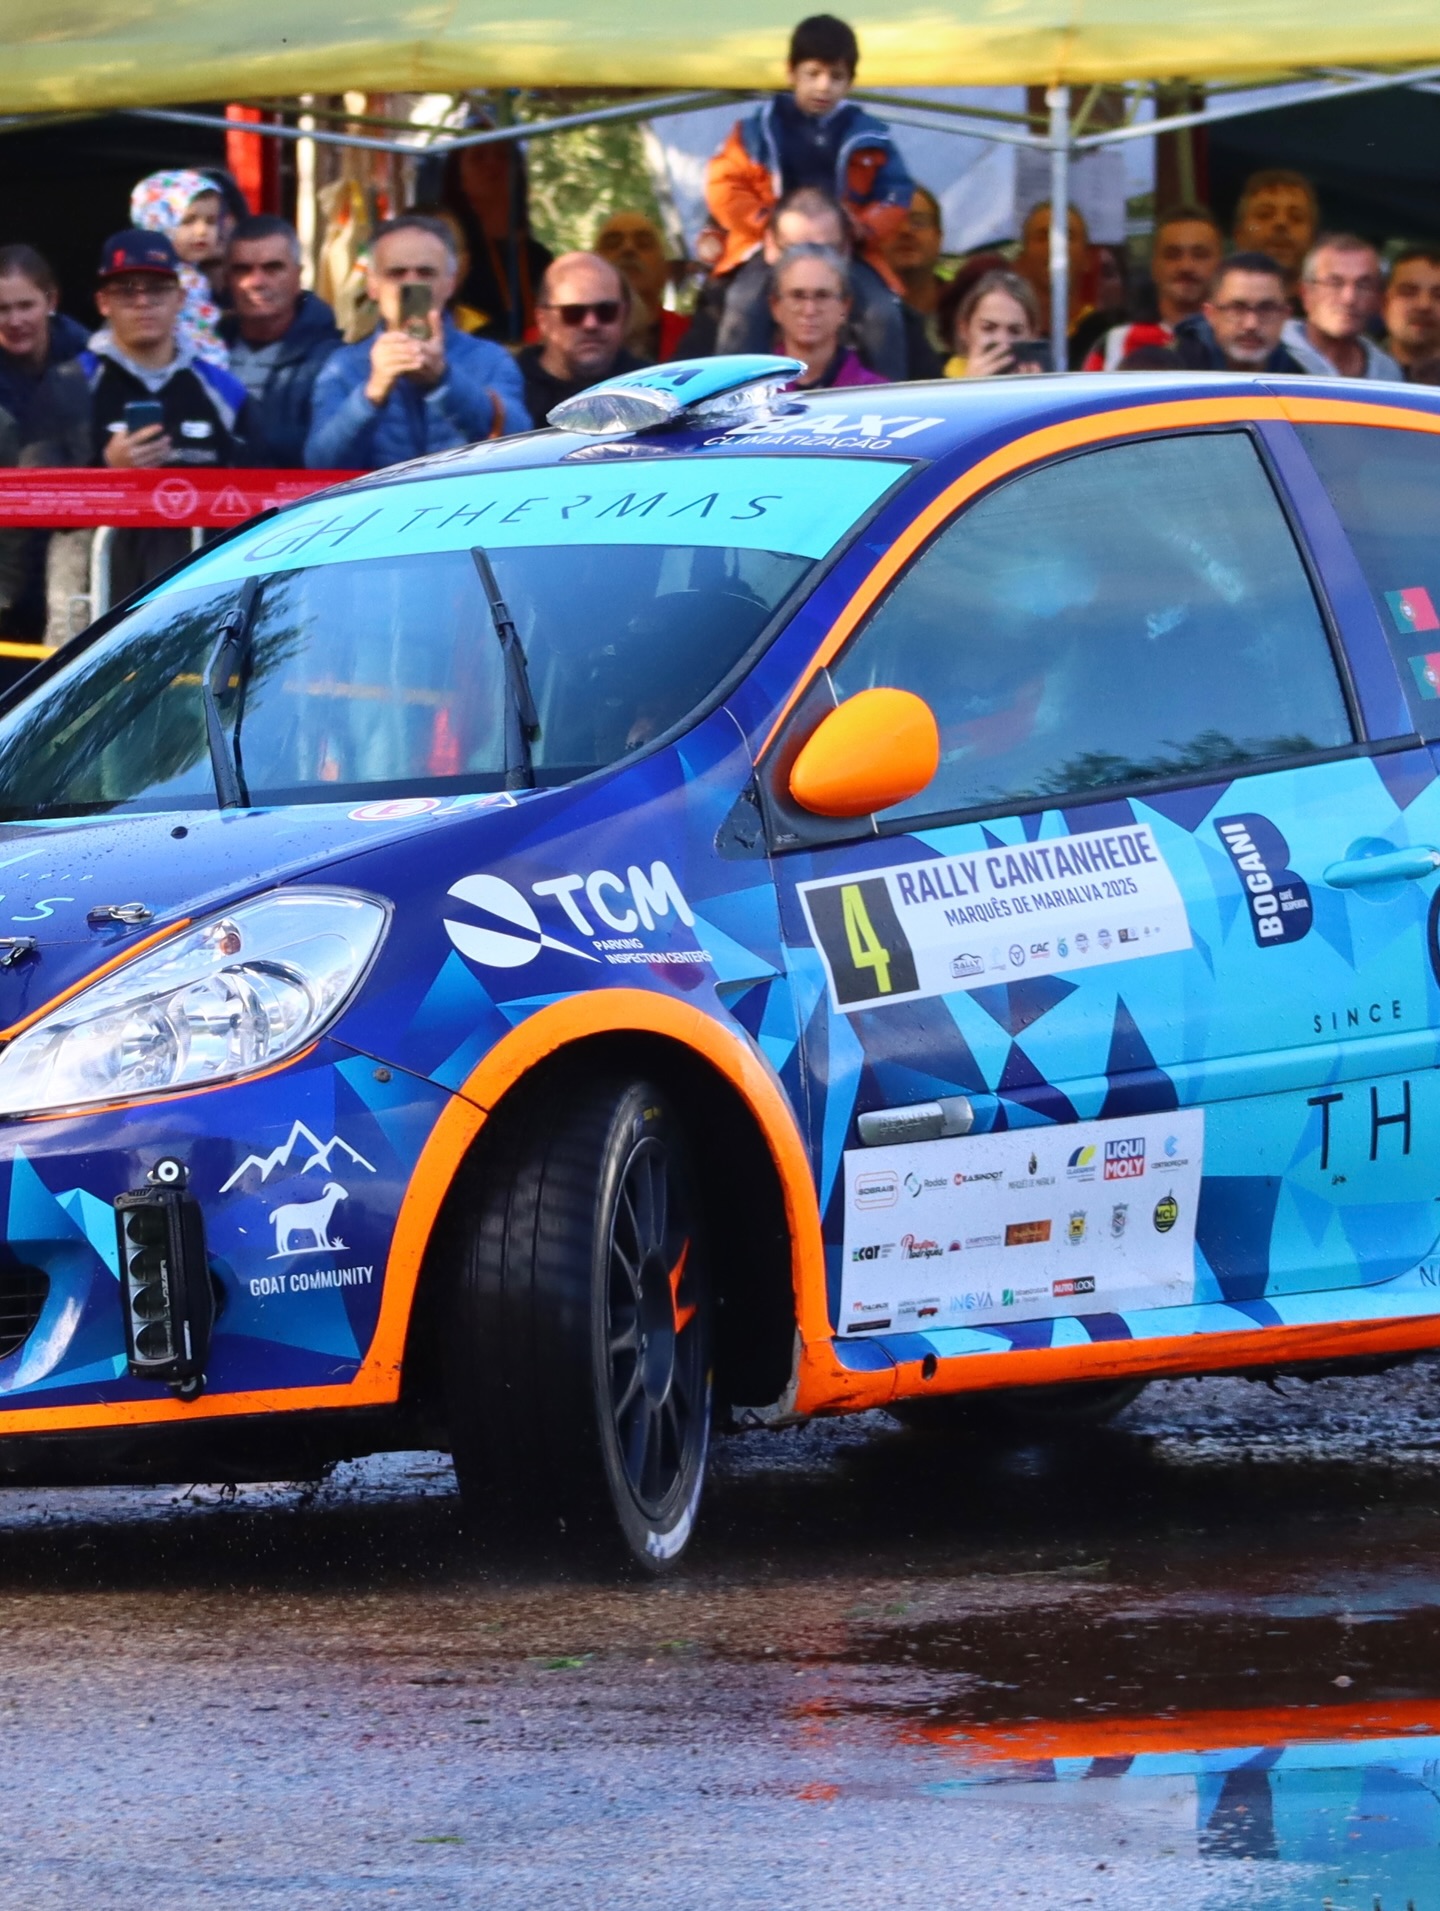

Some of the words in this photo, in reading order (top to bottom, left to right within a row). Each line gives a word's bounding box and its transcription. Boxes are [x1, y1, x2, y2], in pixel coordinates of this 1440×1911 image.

[703, 435, 892, 450] CLIMATIZAÇÃO
[725, 414, 946, 438] BAXI
[244, 508, 384, 562] GH
[397, 492, 784, 533] THERMAS
[895, 860, 980, 906] RALLY
[986, 831, 1158, 889] CANTANHEDE
[1220, 823, 1284, 938] BOGANI
[532, 861, 696, 936] TCM
[944, 897, 1012, 927] MARQUÊS
[1014, 892, 1033, 914] DE
[1033, 883, 1101, 912] MARIALVA
[1102, 877, 1138, 899] 2025
[592, 938, 643, 951] PARKING
[840, 884, 893, 993] 4
[605, 952, 668, 964] INSPECTION
[667, 950, 713, 964] CENTERS
[1313, 1000, 1401, 1033] SINCE
[1307, 1080, 1411, 1170] TH
[1106, 1138, 1144, 1159] LIQUI
[1105, 1158, 1143, 1179] MOLY
[250, 1275, 286, 1296] GOAT
[290, 1265, 373, 1292] COMMUNITY
